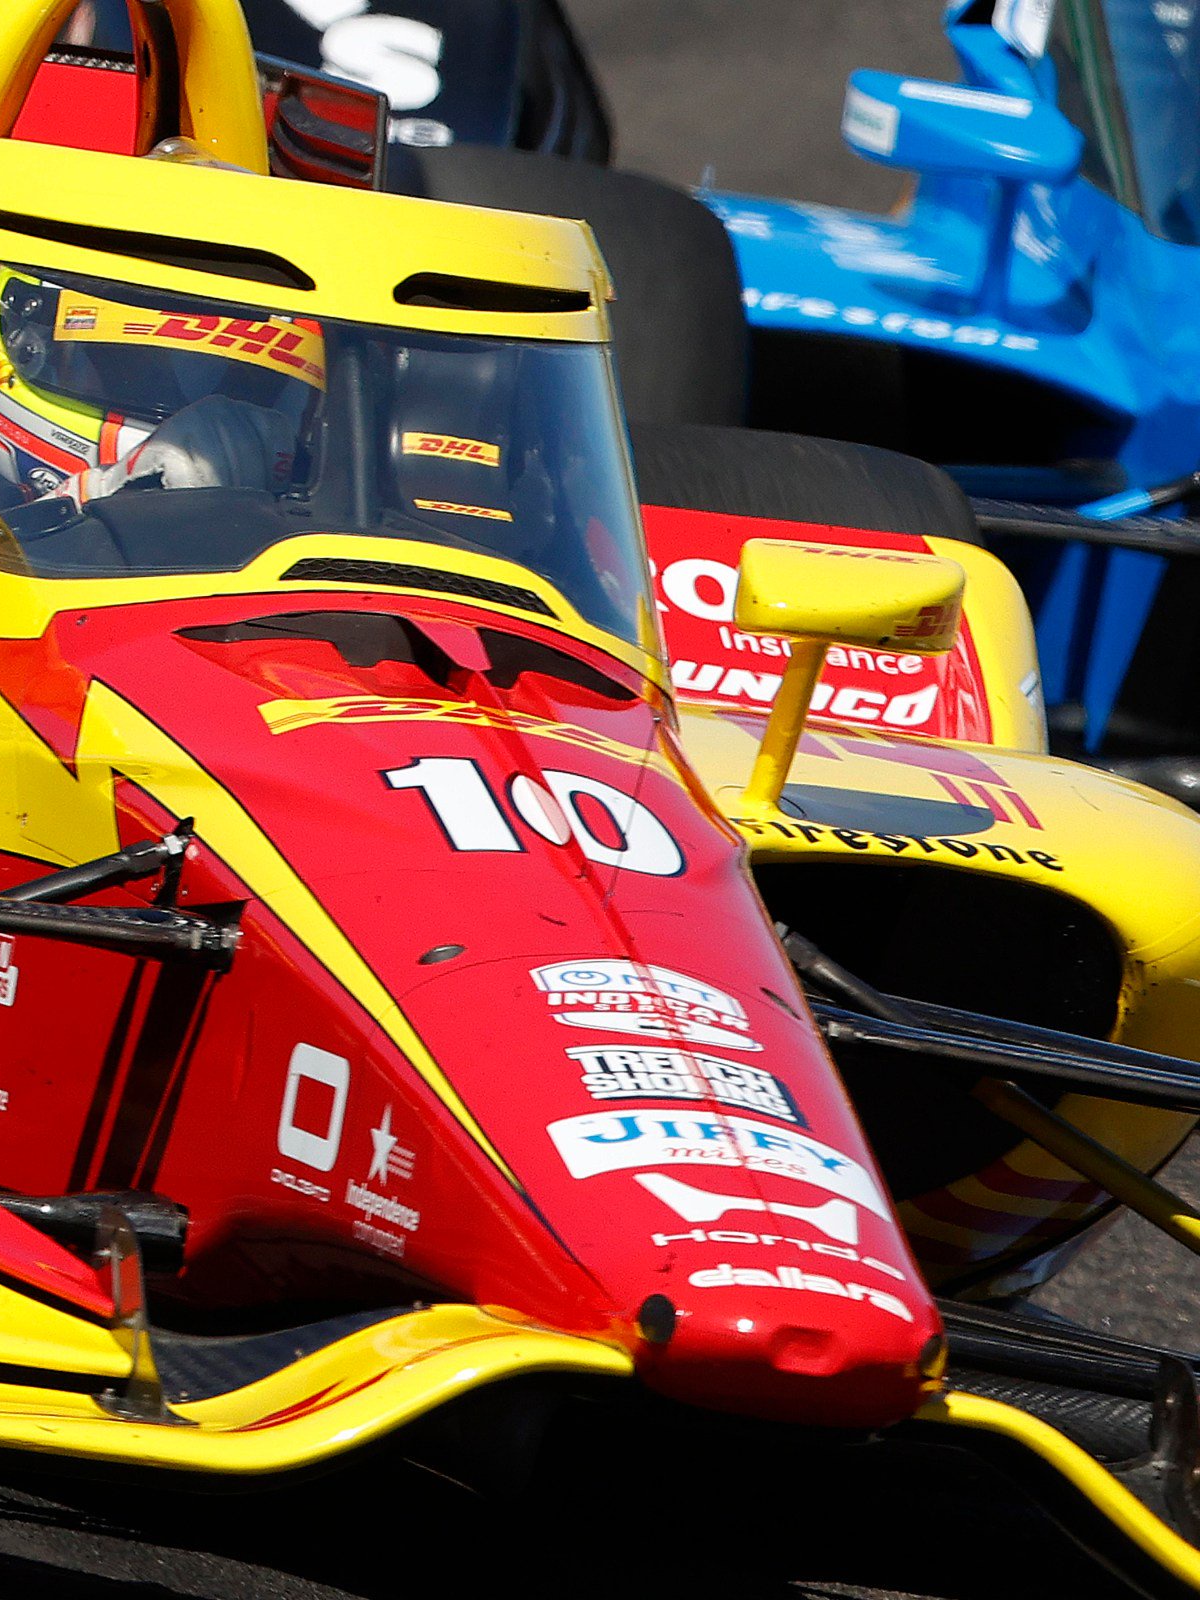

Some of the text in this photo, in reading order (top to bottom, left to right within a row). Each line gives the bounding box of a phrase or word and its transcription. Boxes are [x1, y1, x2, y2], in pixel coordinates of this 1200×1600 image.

[153, 310, 308, 370] DHL
[417, 437, 486, 460] DHL
[719, 626, 923, 675] Insance
[378, 756, 687, 878] 10
[728, 817, 1065, 872] Firestone
[547, 991, 752, 1032] INDYCAR
[581, 1116, 852, 1175] JIFFY
[344, 1178, 421, 1232] Independence
[687, 1262, 914, 1324] dallara
